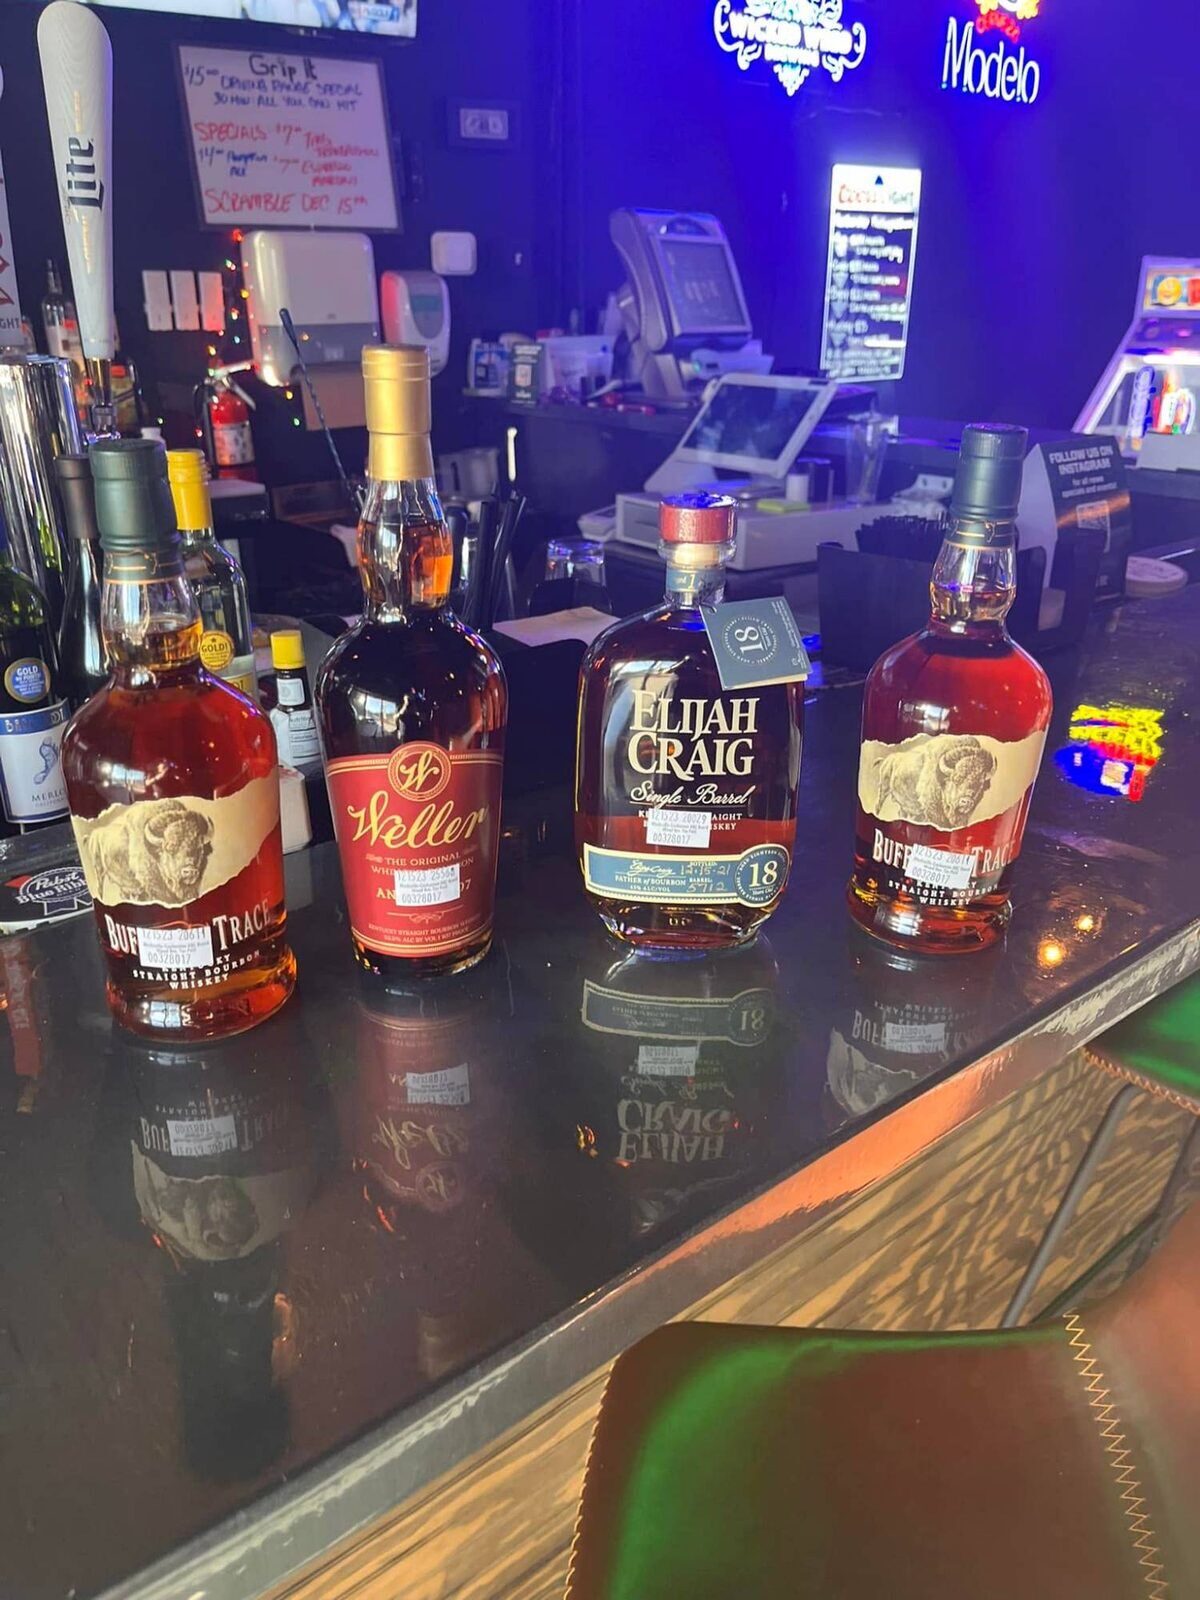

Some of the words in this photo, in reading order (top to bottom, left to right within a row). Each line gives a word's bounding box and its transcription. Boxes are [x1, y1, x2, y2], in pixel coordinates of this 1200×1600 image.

[249, 54, 297, 83] Grip
[942, 17, 1040, 103] Modelo
[194, 122, 267, 142] SPECIALS
[66, 137, 105, 211] Lite
[205, 189, 295, 214] SCRAMBLE
[302, 193, 331, 212] DEC
[0, 317, 20, 330] GHT
[1048, 449, 1086, 464] FOLLOW
[1086, 447, 1100, 459] US
[1100, 445, 1114, 456] ON
[1058, 458, 1112, 475] INSTAGRAM
[201, 642, 228, 653] GOLD!
[735, 626, 767, 655] 18
[17, 665, 39, 676] GOLD
[629, 689, 760, 742] ELIJAH
[628, 731, 755, 781] CRAIG
[631, 780, 684, 810] Single
[687, 783, 757, 805] Barrel
[347, 790, 487, 849] Weller
[711, 822, 737, 831] SKEY
[712, 813, 743, 821] AIGHT
[384, 856, 408, 866] THE
[409, 851, 460, 866] ORIGINAL
[873, 828, 913, 870] BUFF
[970, 840, 1015, 878] TRACE
[34, 870, 80, 891] Pabst
[615, 875, 642, 885] FATHER
[651, 878, 686, 886] BOURBON
[749, 860, 778, 888] 18
[15, 887, 54, 904] Blue
[55, 878, 88, 894] Ribb
[888, 879, 946, 898] STRAIGHT
[952, 884, 998, 898] BOURBON
[919, 896, 971, 906] WHISKEY
[213, 898, 271, 951] TRACE
[132, 969, 197, 982] STRAIGHT
[204, 949, 260, 977] BOURBON
[169, 973, 230, 990] WHISKEY
